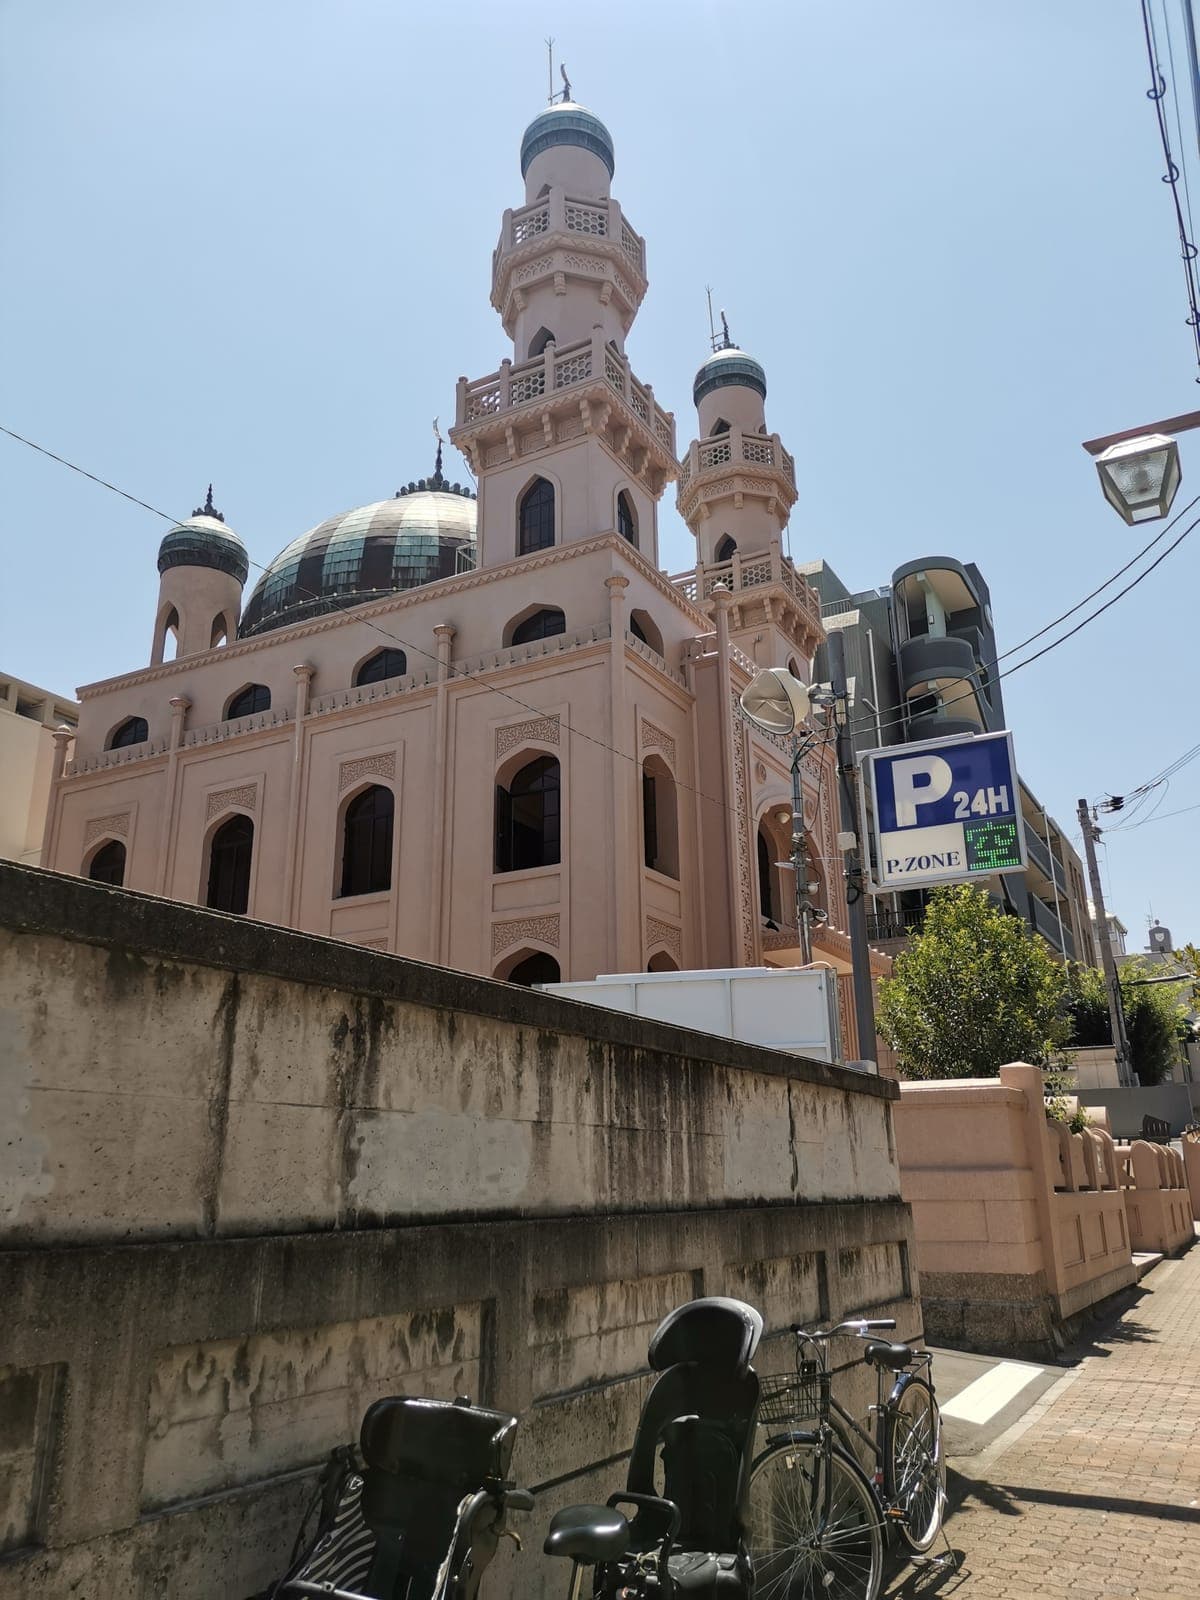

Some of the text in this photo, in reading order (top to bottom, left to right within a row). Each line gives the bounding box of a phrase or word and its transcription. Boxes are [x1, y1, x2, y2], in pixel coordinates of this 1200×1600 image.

[891, 755, 952, 827] P
[953, 785, 1009, 819] 24H
[887, 851, 960, 874] P.ZONE
[966, 821, 1018, 870] 空
